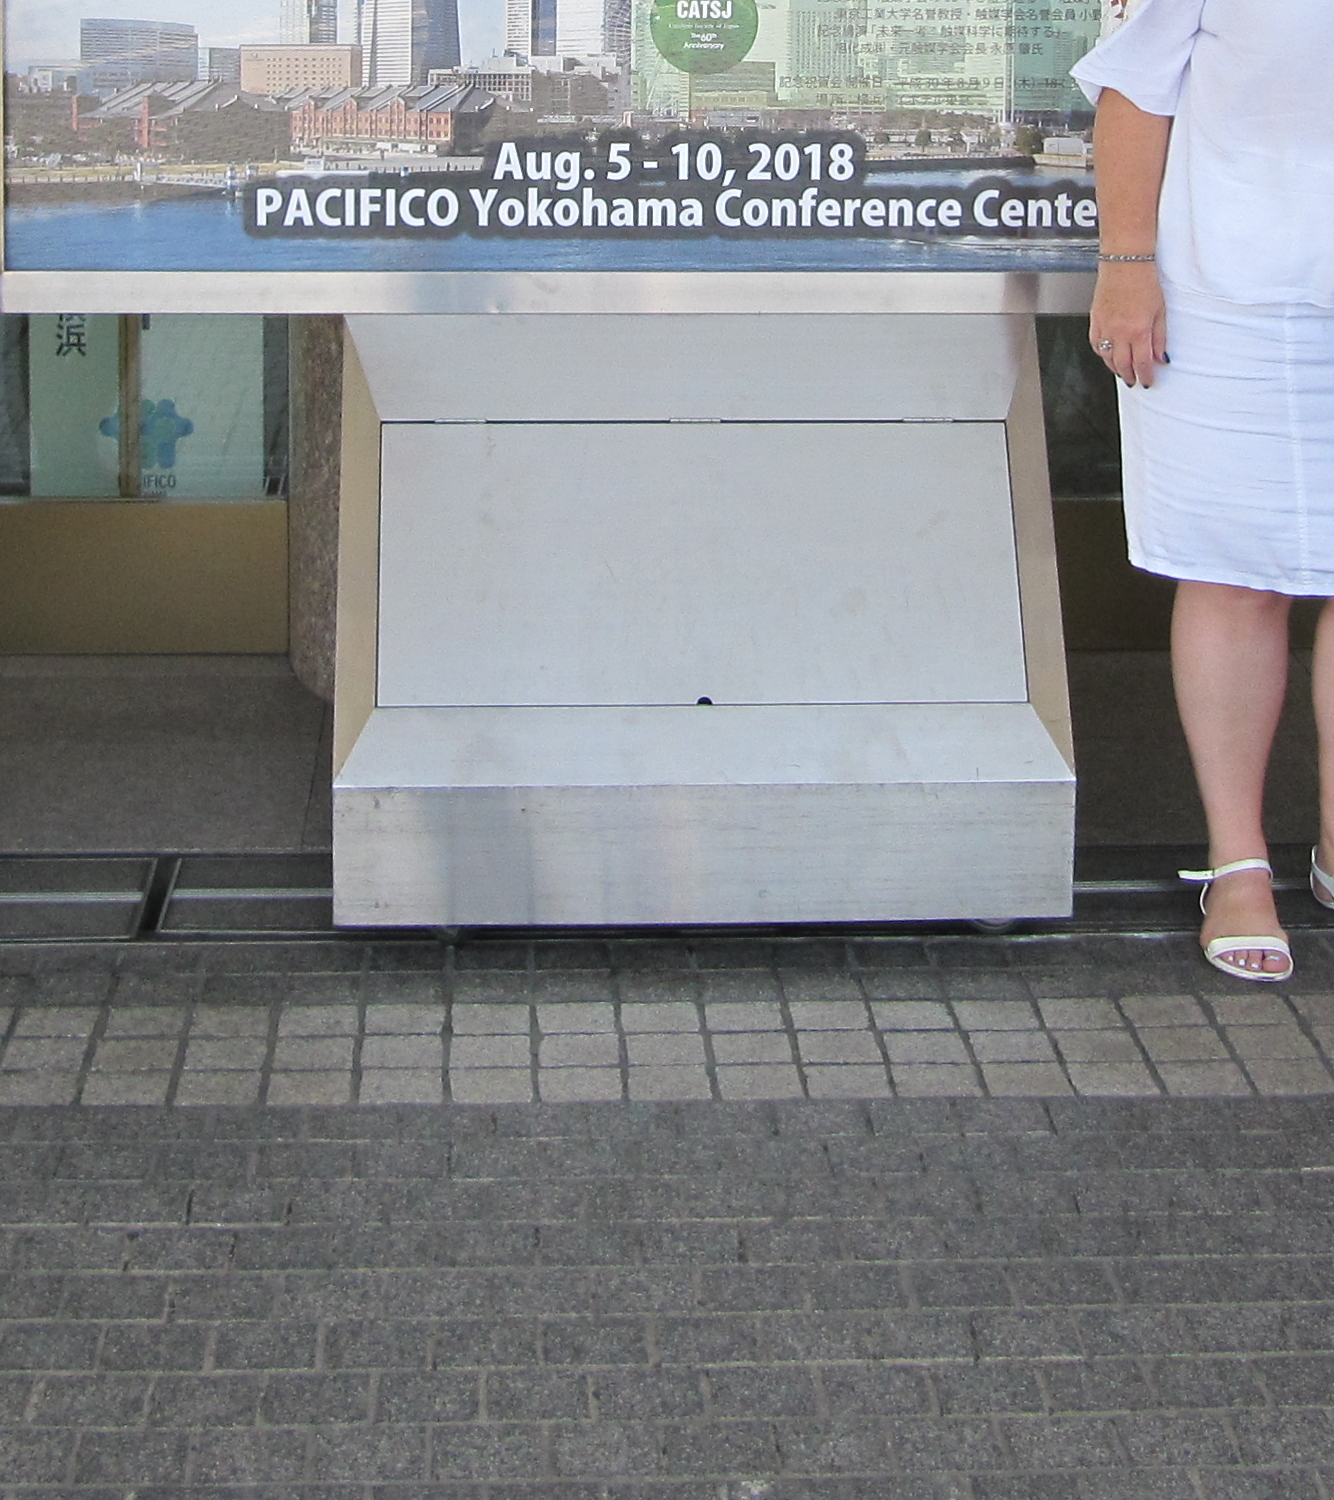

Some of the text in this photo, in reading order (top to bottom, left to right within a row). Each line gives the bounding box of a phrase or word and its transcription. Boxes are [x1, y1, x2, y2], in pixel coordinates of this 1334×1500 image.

[676, 0, 733, 19] CATSJ
[493, 142, 593, 192] Aug.
[606, 143, 632, 181] 5
[672, 142, 736, 186] 10,
[747, 142, 854, 182] 2018
[255, 188, 1097, 229] PACIFICO Yokohama Conference Cente
[143, 474, 177, 489] IFICO
